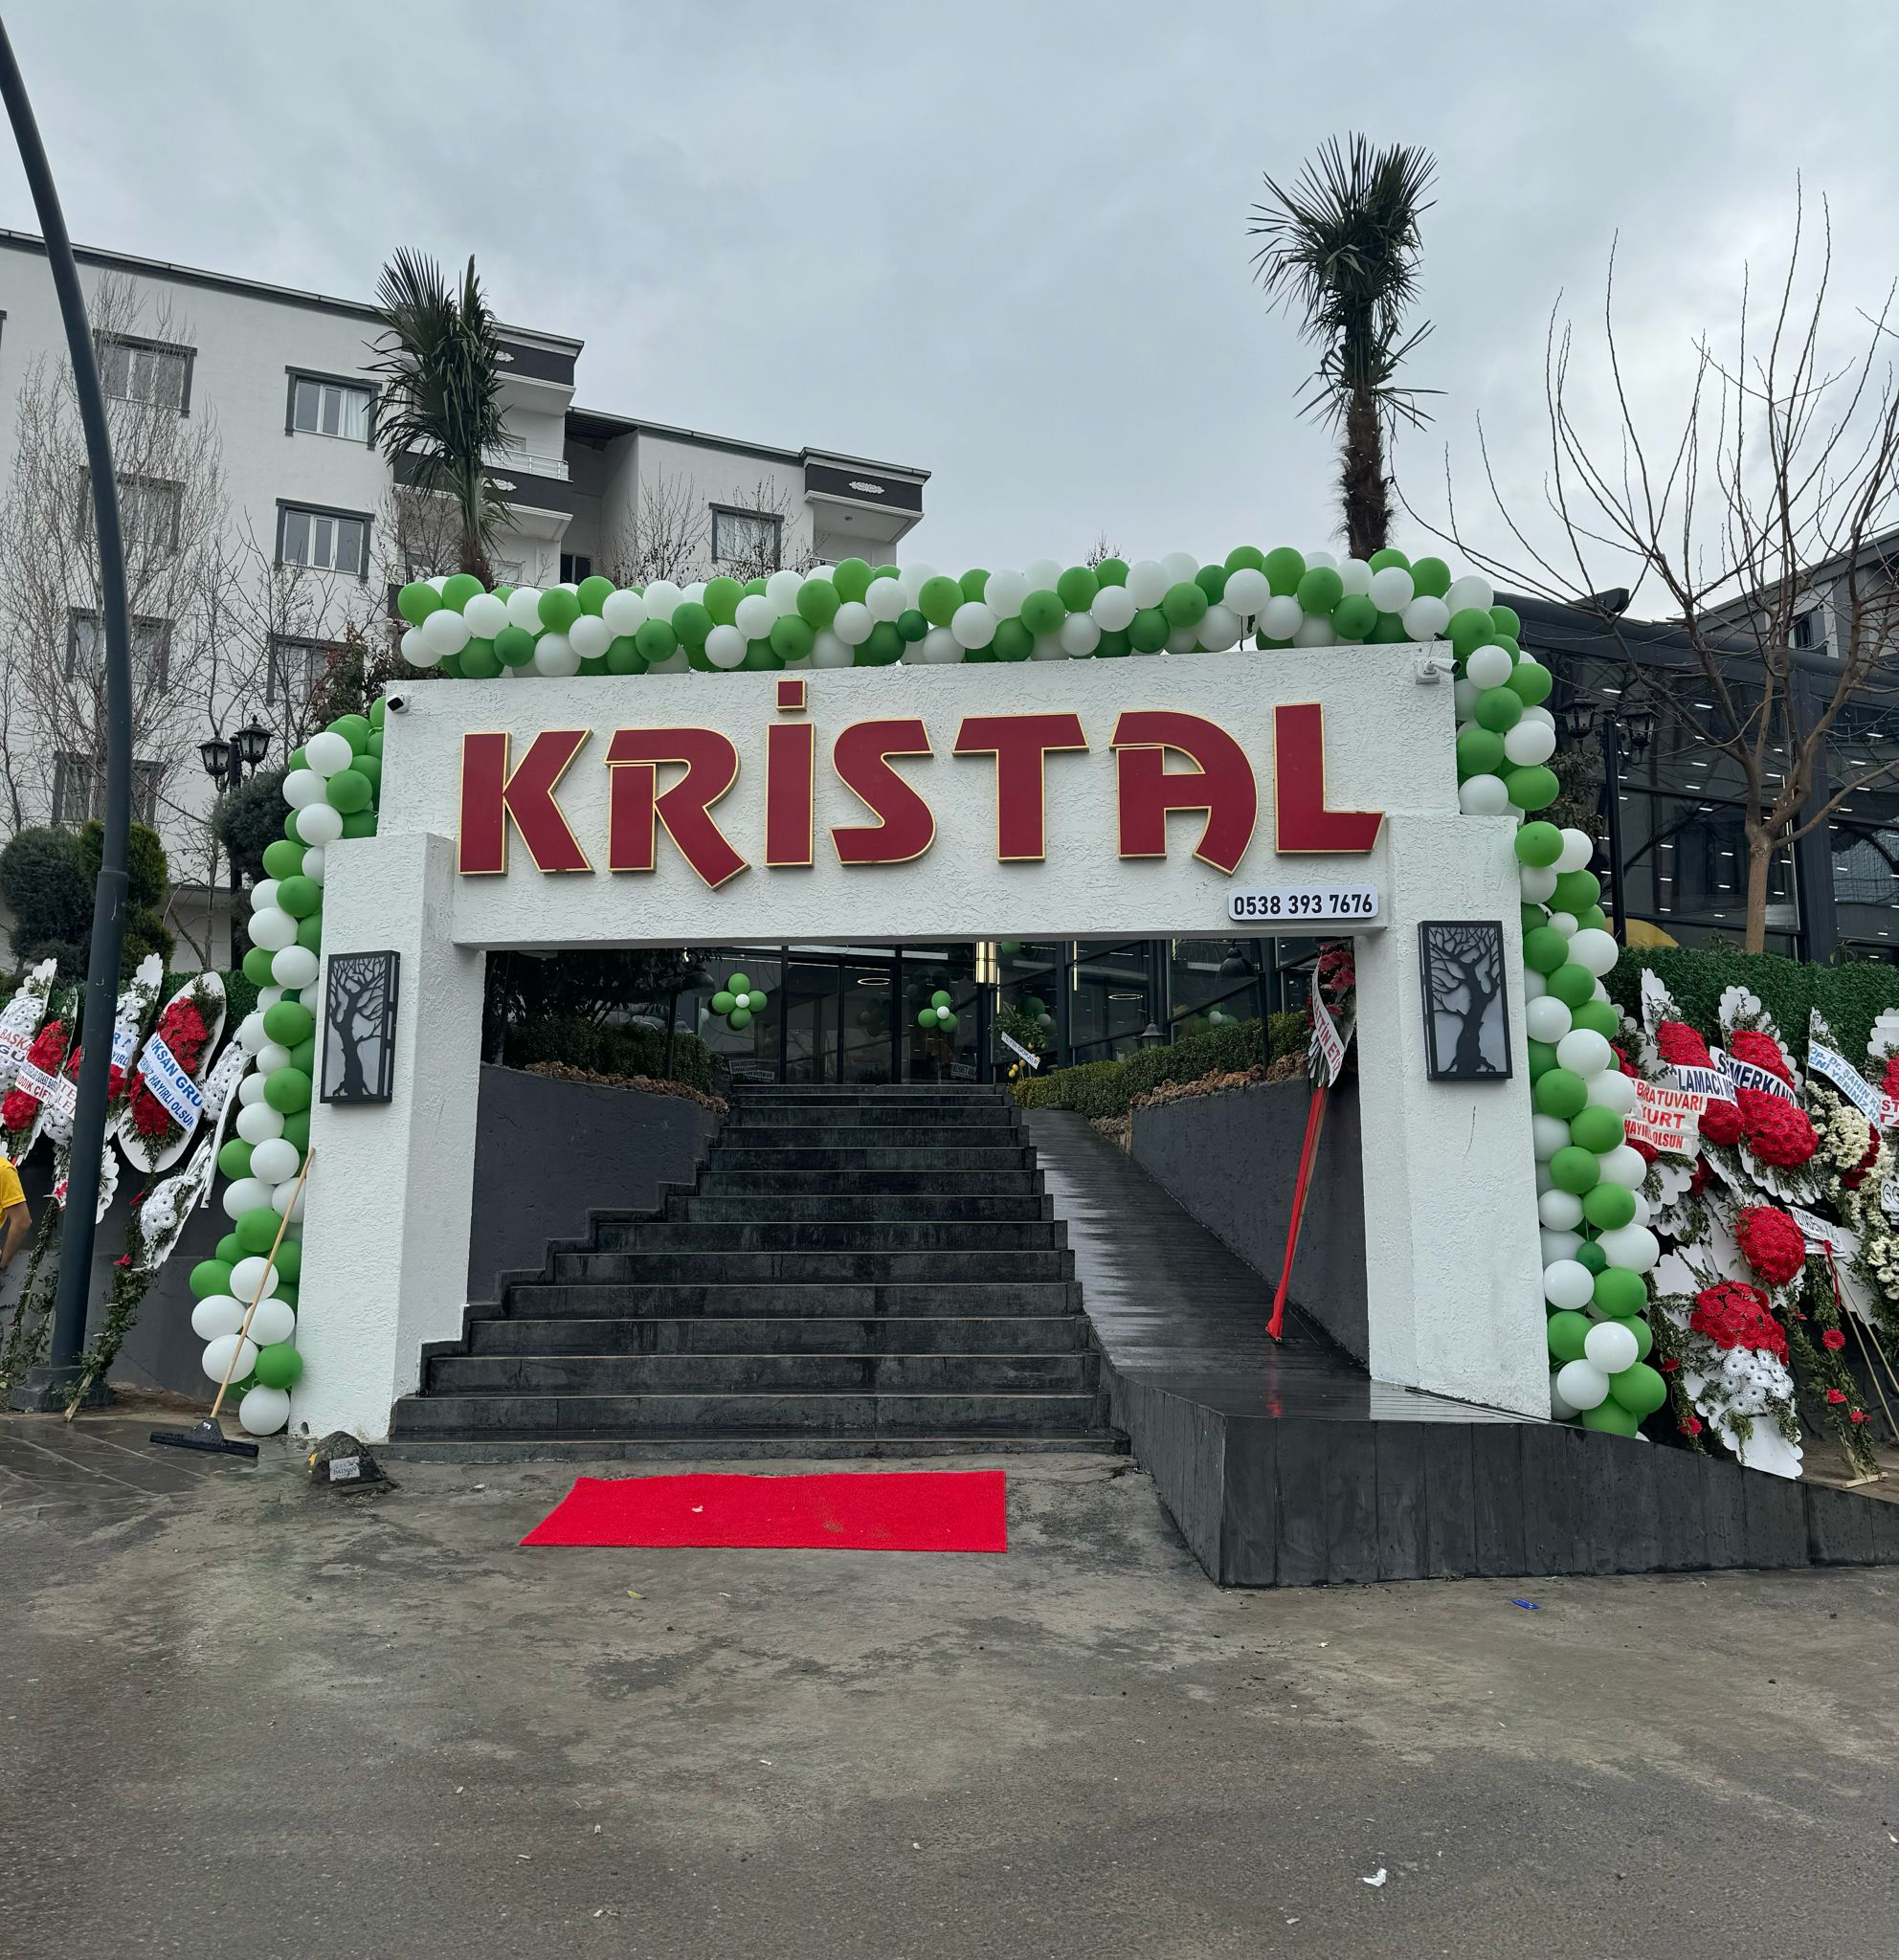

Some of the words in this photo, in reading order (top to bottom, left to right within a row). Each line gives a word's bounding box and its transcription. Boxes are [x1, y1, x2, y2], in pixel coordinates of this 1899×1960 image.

[458, 679, 1388, 891] KRİSTAL
[1234, 896, 1282, 916] 0538
[1288, 895, 1323, 914] 393
[1329, 894, 1373, 913] 7676
[148, 1075, 174, 1105] HAYIRLI
[1642, 1104, 1686, 1129] YURT
[1652, 1131, 1684, 1148] OLSUN
